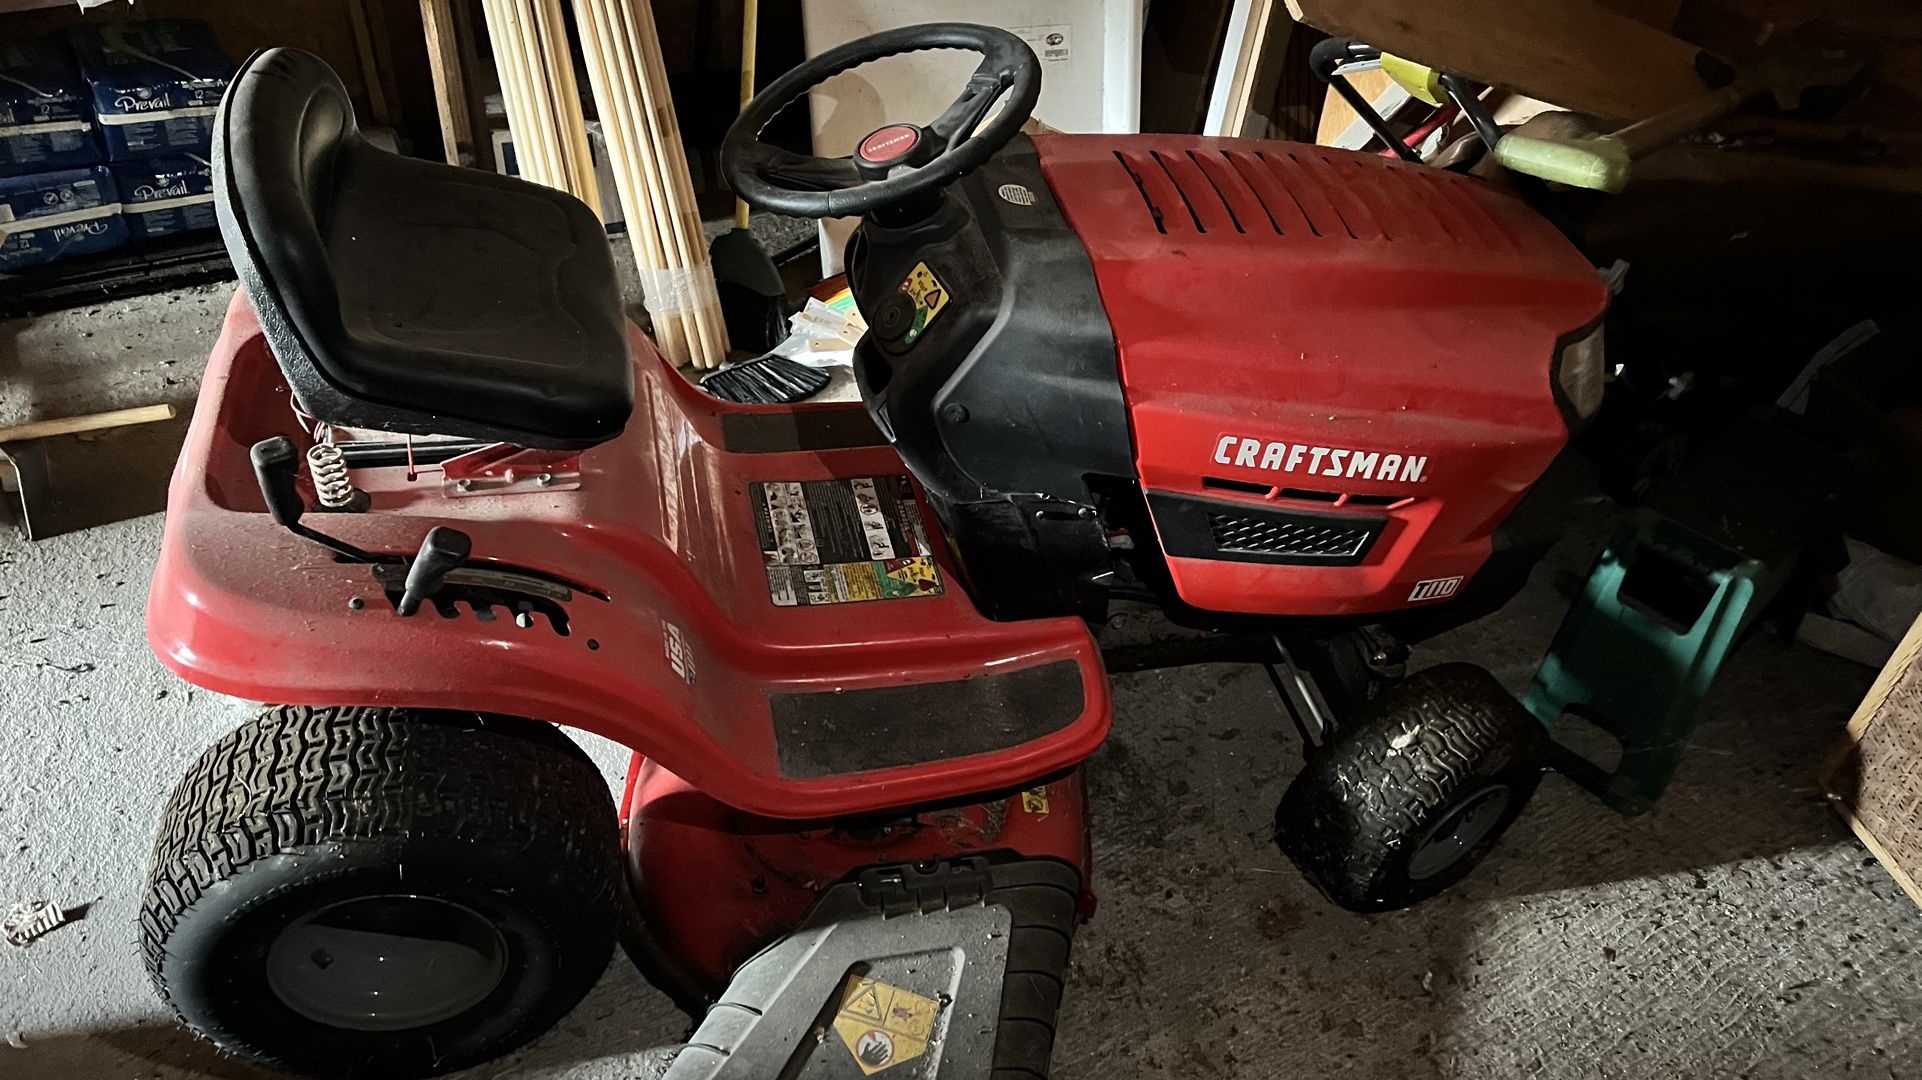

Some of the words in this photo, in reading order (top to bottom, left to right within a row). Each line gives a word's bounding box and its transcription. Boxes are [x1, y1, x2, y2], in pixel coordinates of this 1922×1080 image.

[114, 92, 171, 112] Prevail
[134, 180, 188, 200] Prevail
[53, 221, 108, 242] Prevail
[1214, 437, 1425, 482] CRAFTSMAN
[666, 622, 686, 679] USA
